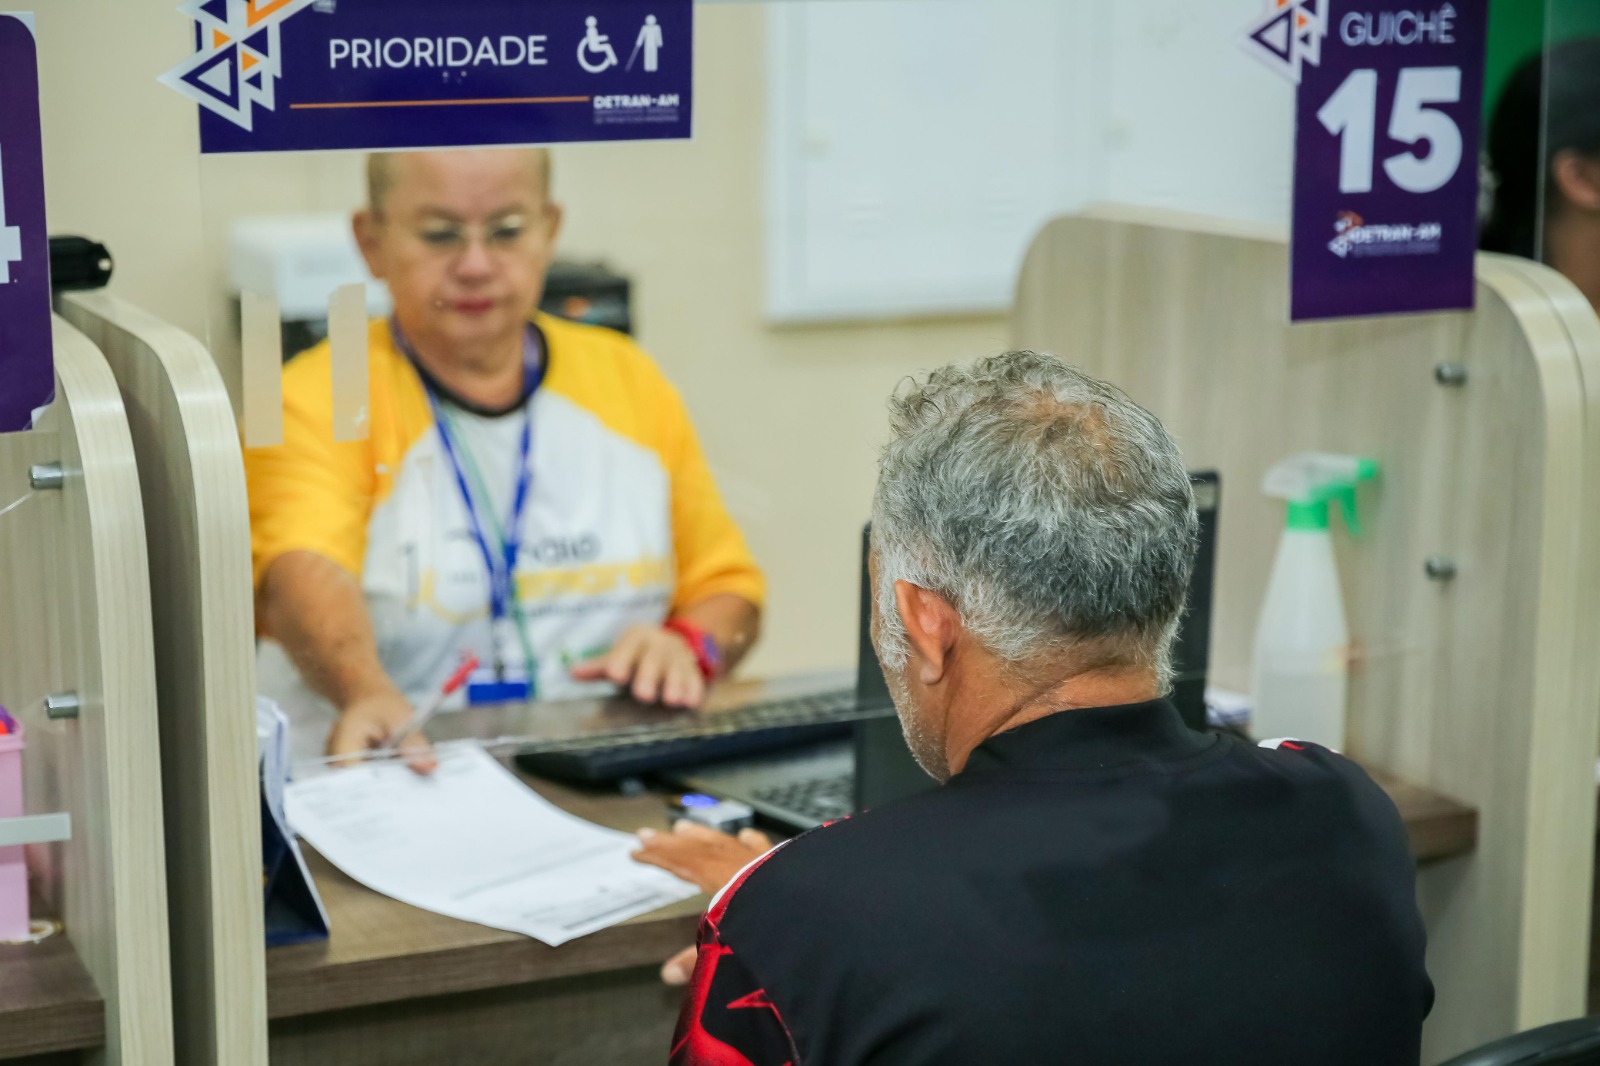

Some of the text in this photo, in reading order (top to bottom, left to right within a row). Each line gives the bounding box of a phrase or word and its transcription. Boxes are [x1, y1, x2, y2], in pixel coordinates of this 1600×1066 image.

[1340, 4, 1456, 46] GUICHÊ
[328, 36, 548, 69] PRIORIDADE
[1317, 66, 1463, 193] 15
